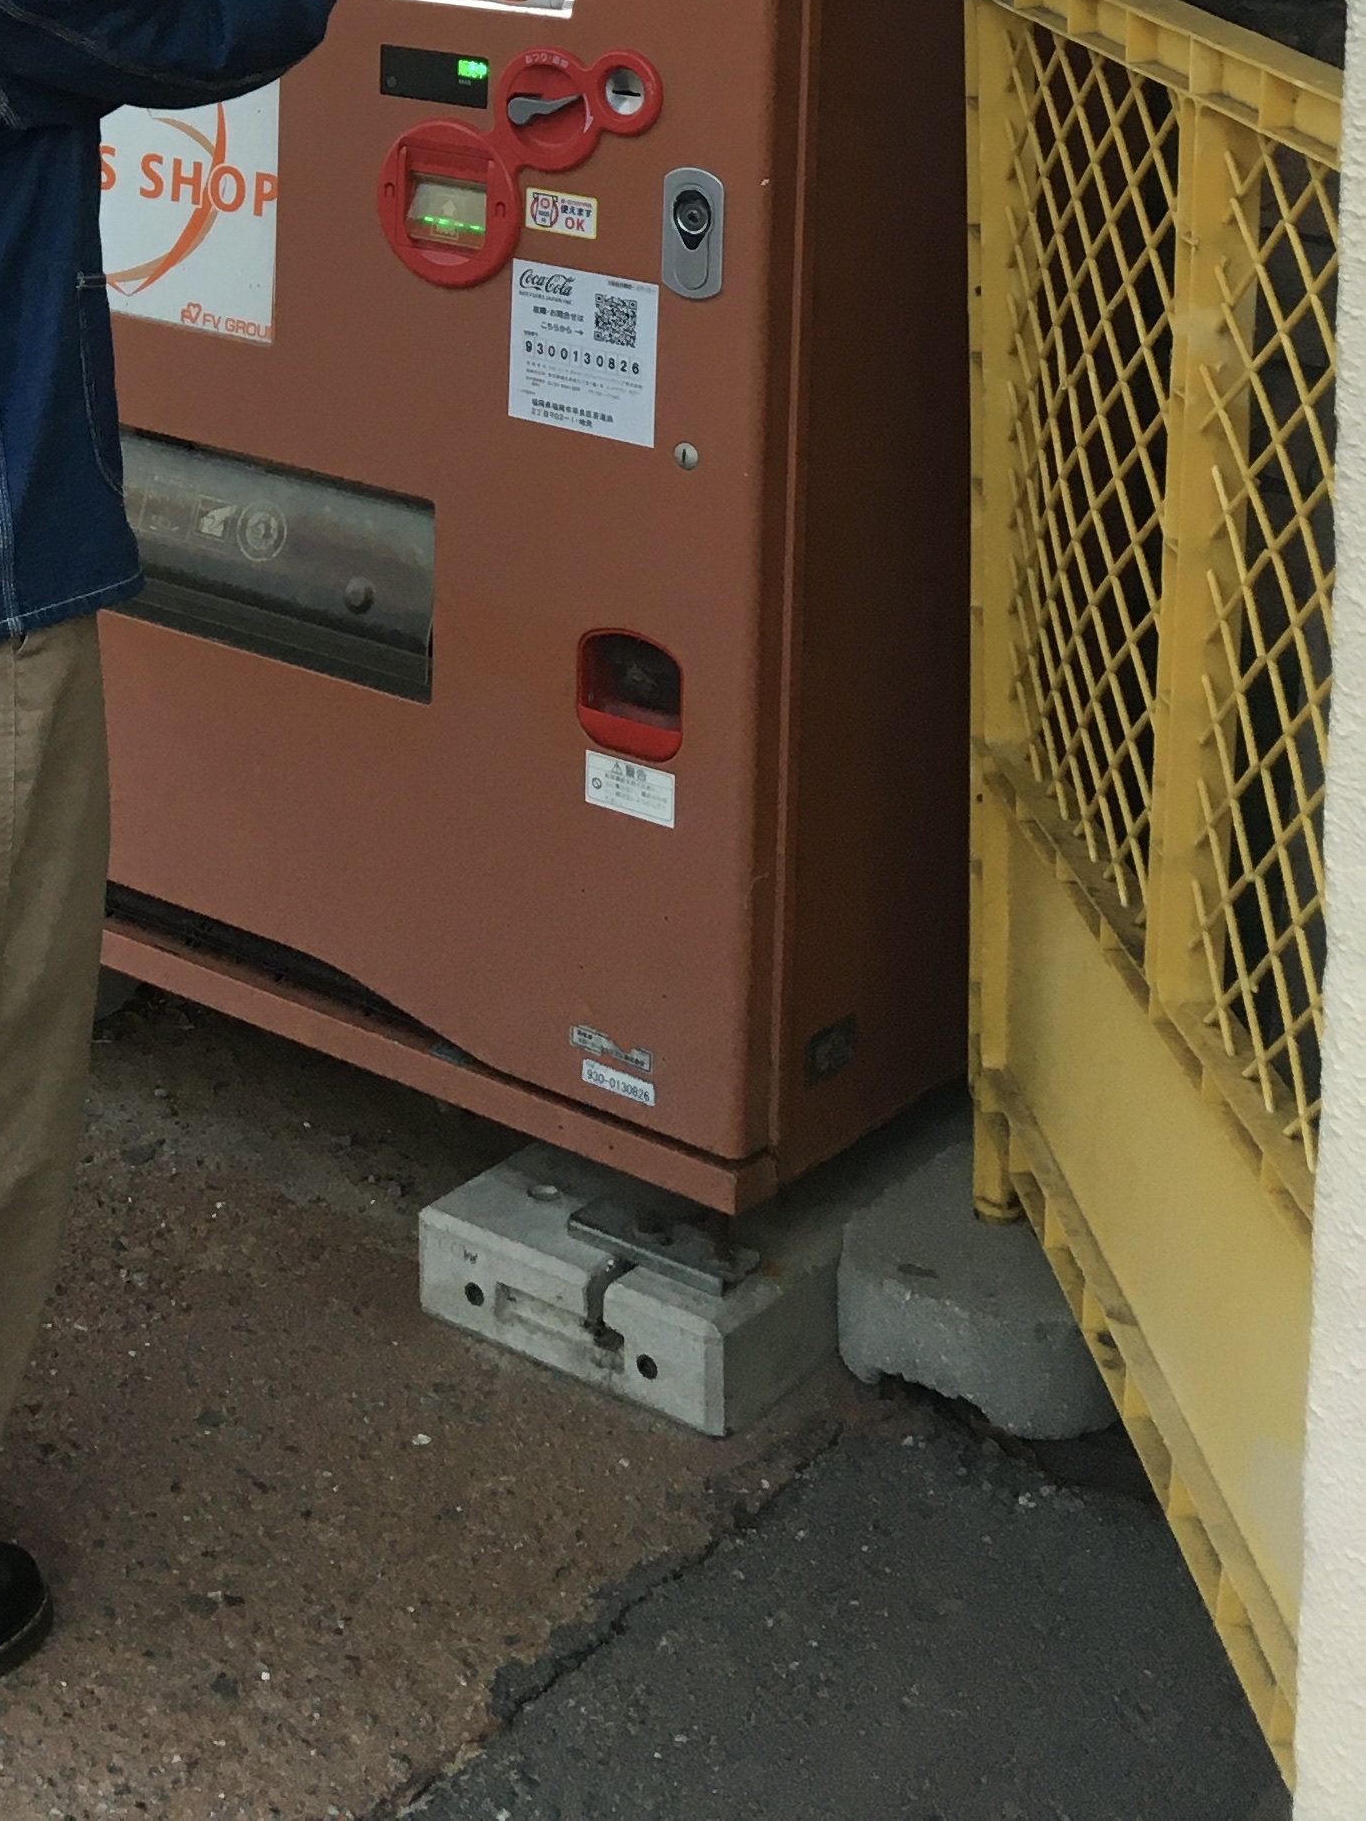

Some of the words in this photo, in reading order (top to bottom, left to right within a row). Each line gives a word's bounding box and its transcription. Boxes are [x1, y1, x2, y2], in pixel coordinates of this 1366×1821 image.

[139, 152, 279, 218] SHOP
[564, 217, 586, 232] OK
[519, 268, 576, 297] Coca-Cola
[202, 312, 222, 331] FV
[540, 321, 573, 334] こちらから
